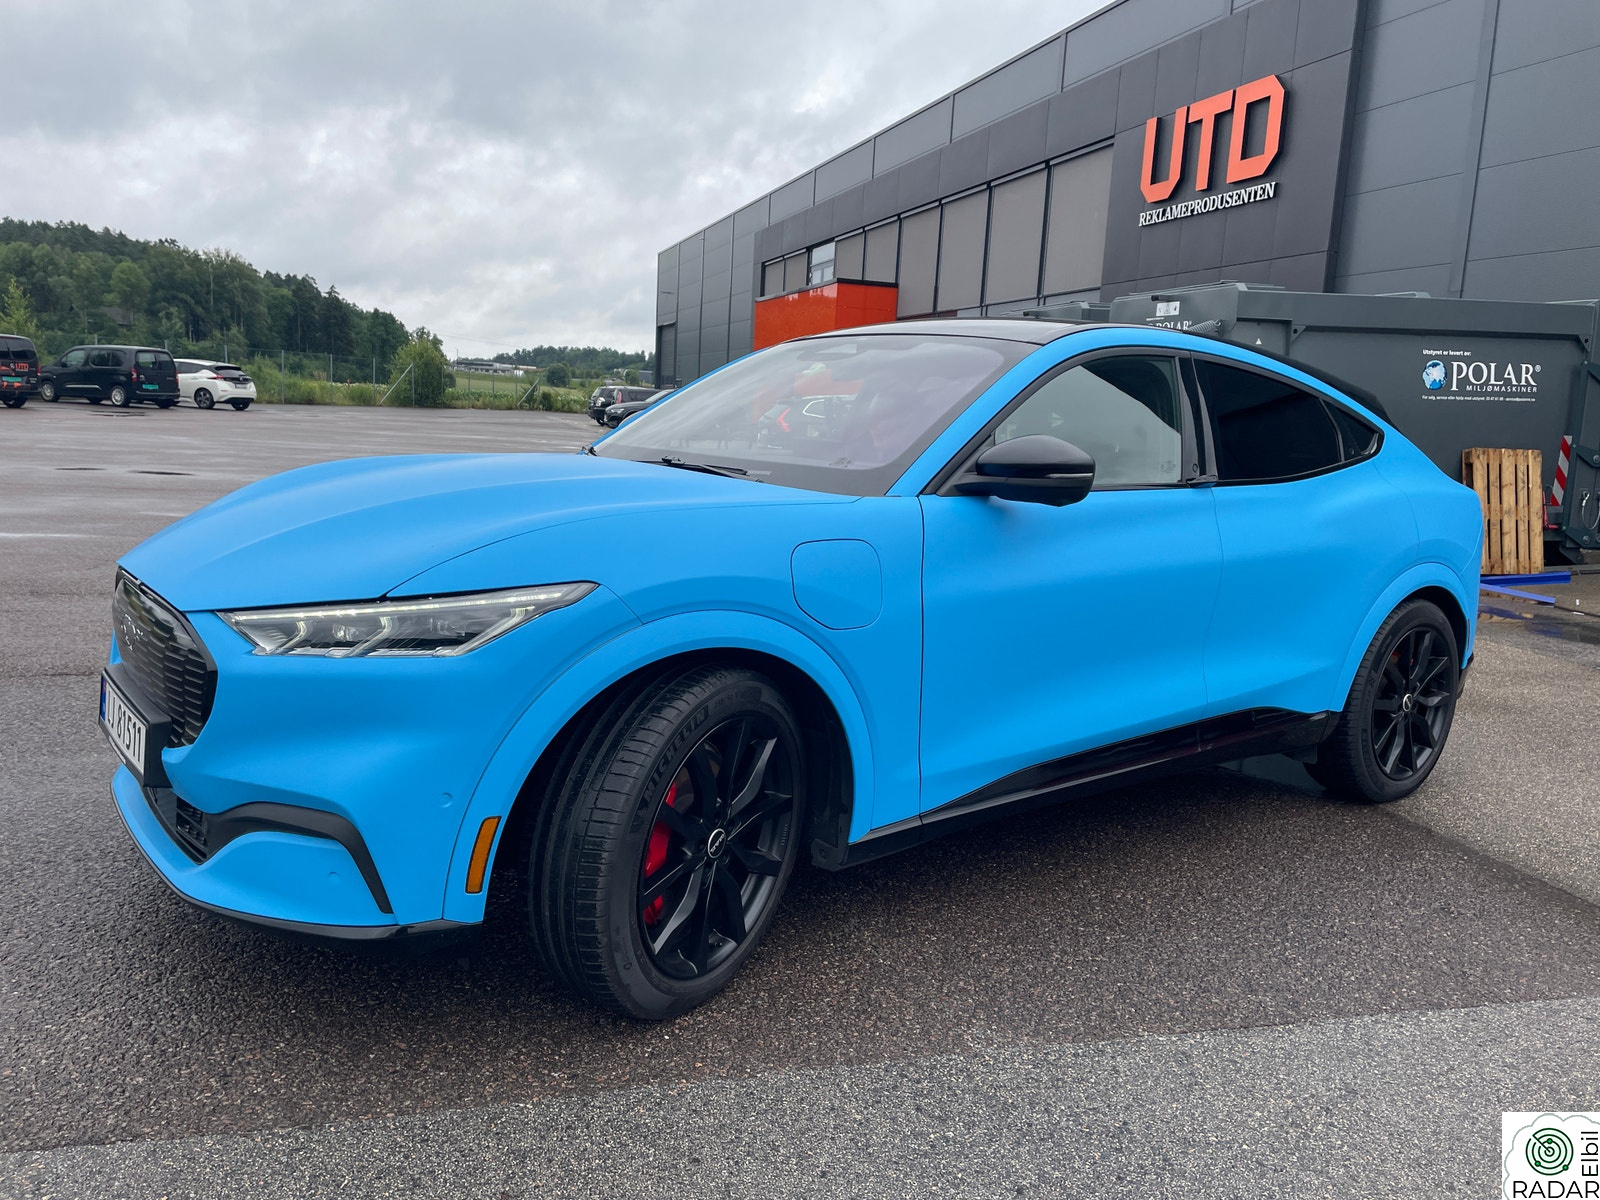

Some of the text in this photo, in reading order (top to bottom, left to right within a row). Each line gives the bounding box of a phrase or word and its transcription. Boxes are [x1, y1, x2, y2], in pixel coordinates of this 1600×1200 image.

[1140, 74, 1285, 203] UTD
[1139, 182, 1277, 227] REKLAMEPRODUSENTEN
[1466, 385, 1538, 393] MILJØMASKINER
[117, 703, 142, 762] 81511
